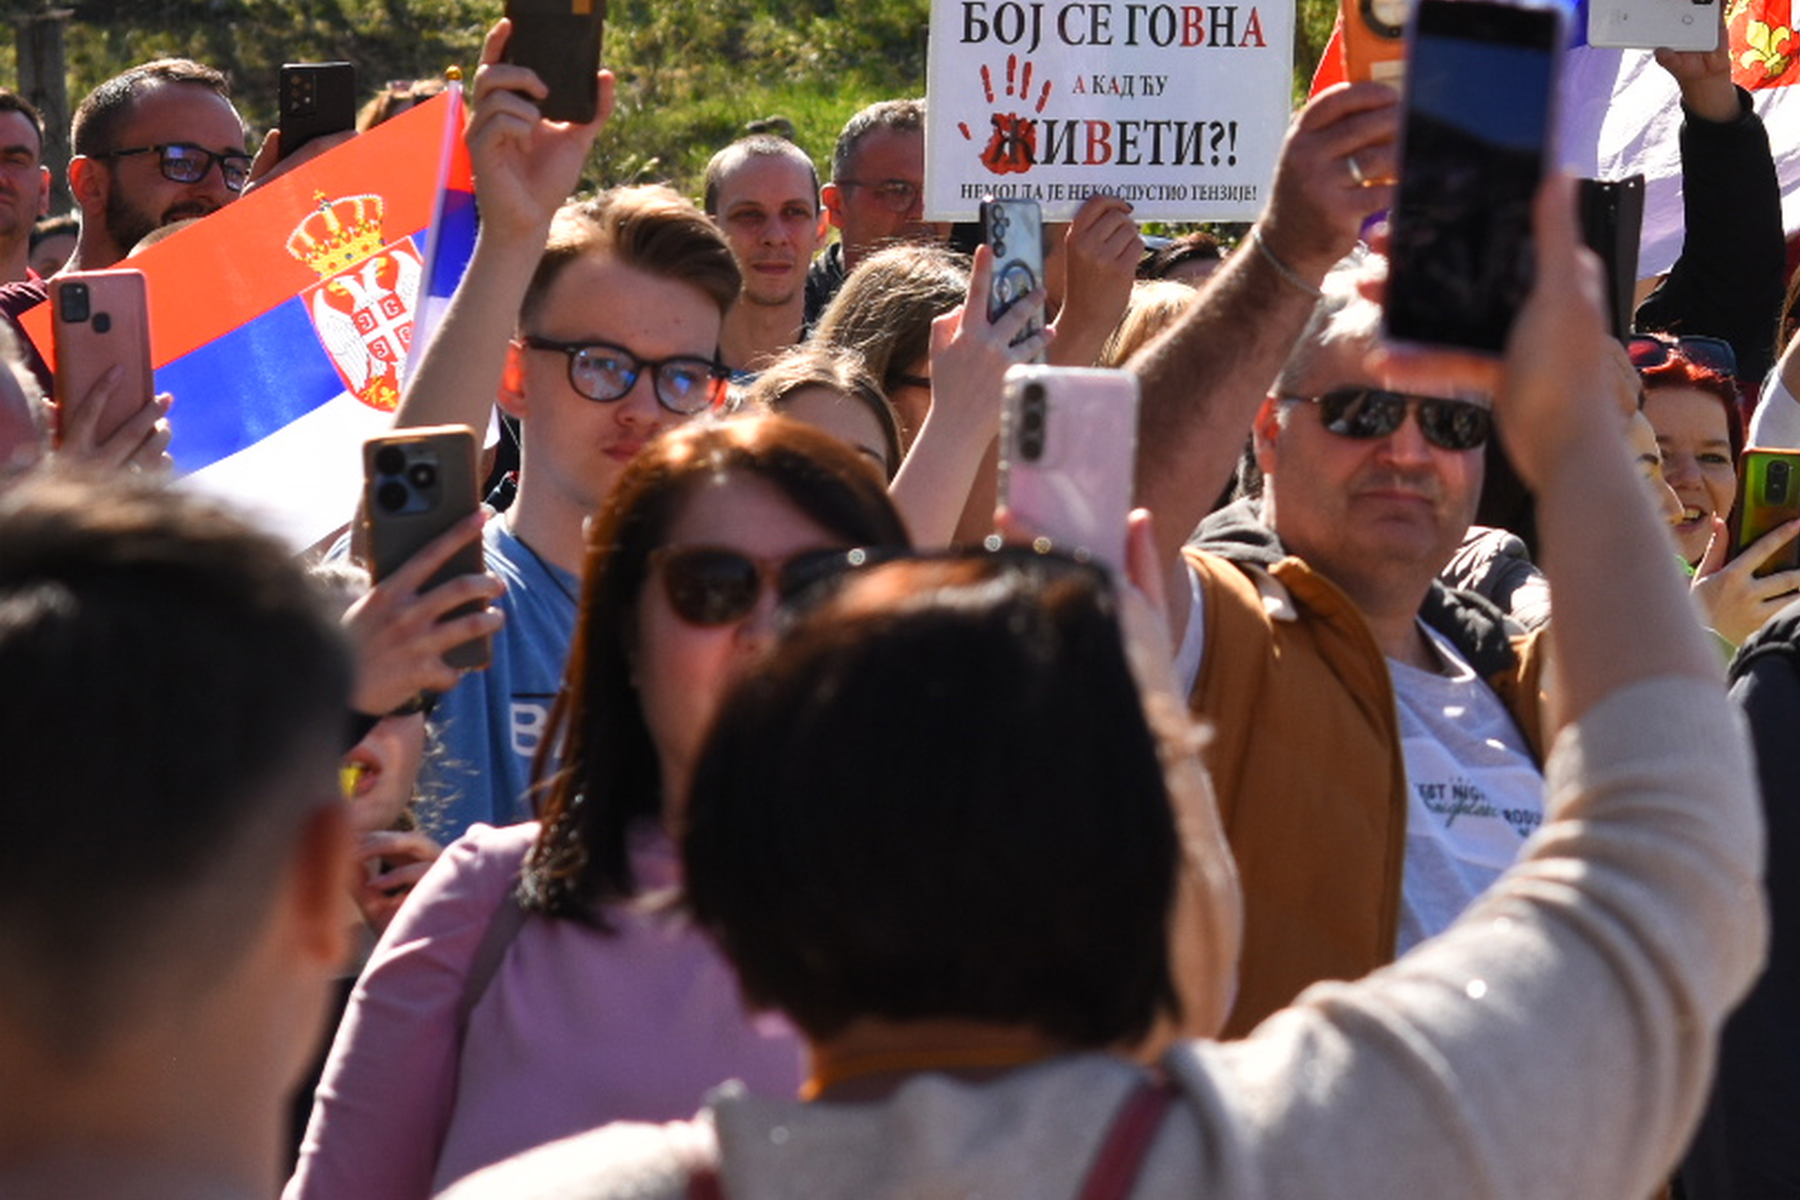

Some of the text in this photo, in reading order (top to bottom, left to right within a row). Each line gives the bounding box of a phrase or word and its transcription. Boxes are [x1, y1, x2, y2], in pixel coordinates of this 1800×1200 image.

[960, 1, 1267, 54] БОЈ СЕ ГОВНА
[1072, 75, 1169, 98] А КАД ЋУ
[989, 118, 1239, 168] ЖИВЕТИ?!
[1047, 184, 1065, 202] ЈЕ
[1191, 185, 1258, 203] ТЕНЗИЈЕ!
